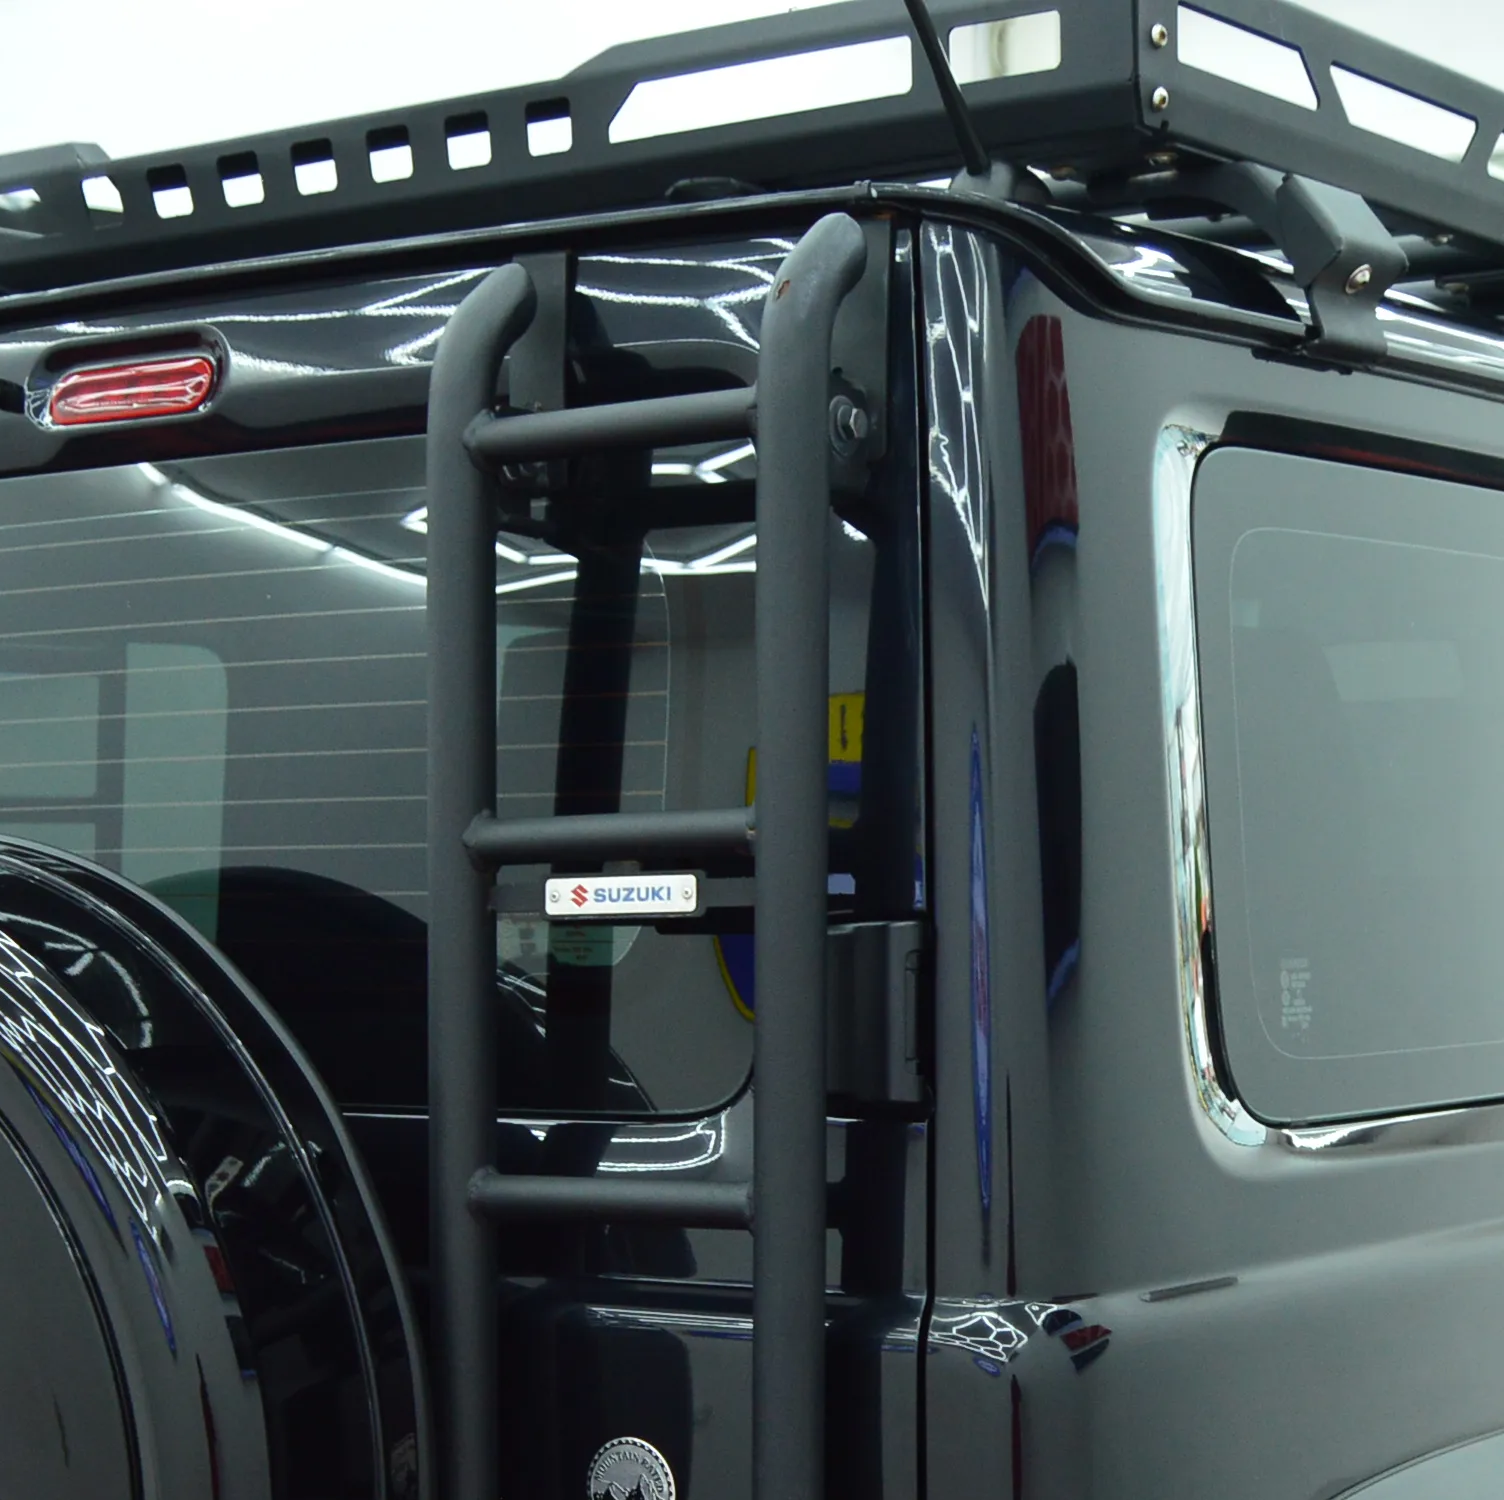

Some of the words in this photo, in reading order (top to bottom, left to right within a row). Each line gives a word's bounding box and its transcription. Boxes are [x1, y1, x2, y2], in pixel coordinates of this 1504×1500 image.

[592, 885, 672, 904] SUZUKI
[594, 1450, 641, 1481] MOUNTAIN
[640, 1457, 664, 1494] RATED
